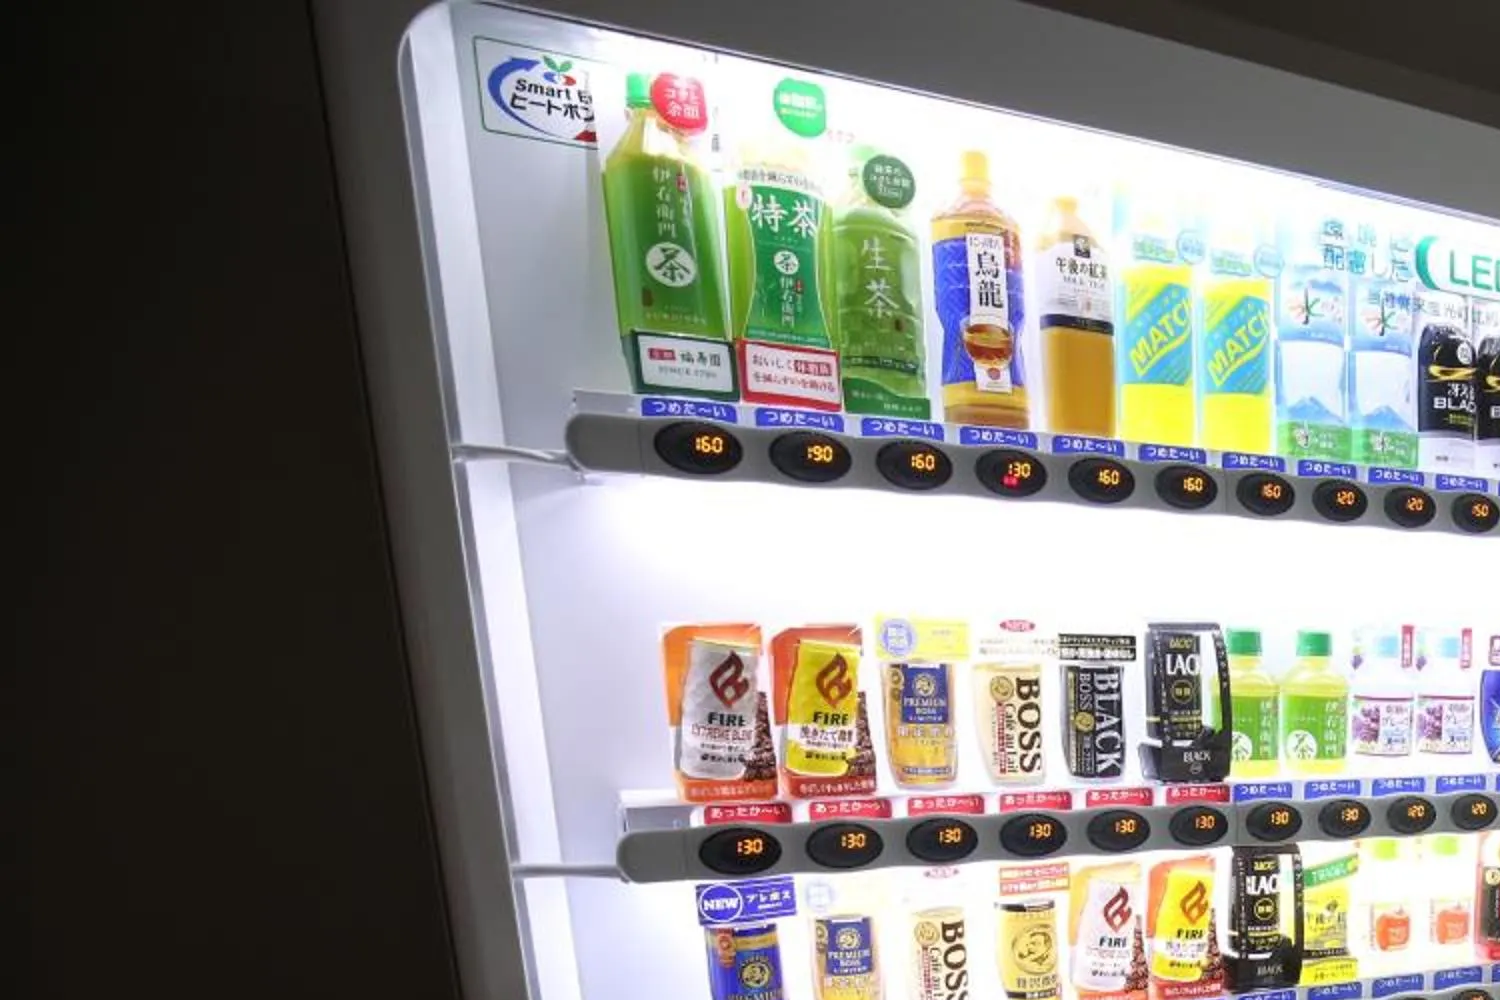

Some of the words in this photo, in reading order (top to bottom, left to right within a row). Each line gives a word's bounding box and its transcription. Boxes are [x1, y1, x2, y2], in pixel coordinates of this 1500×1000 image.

[515, 78, 571, 100] Smart
[751, 194, 819, 237] 特茶
[654, 246, 691, 282] 茶
[861, 237, 899, 318] 生茶
[696, 436, 723, 453] 160
[808, 445, 833, 462] 190
[911, 454, 935, 471] 160
[1008, 462, 1031, 478] 130
[1098, 469, 1120, 485] 160
[1184, 477, 1203, 492] 160
[1078, 673, 1092, 711] BOSS
[1016, 676, 1041, 774] BOSS
[1094, 673, 1122, 774] BLACK
[1196, 816, 1215, 829] 130
[1272, 811, 1289, 825] 130
[1031, 824, 1052, 838] 130
[1116, 819, 1136, 834] 130
[842, 833, 866, 848] 130
[940, 828, 961, 843] 130
[737, 838, 763, 854] 130
[703, 897, 739, 911] NEW
